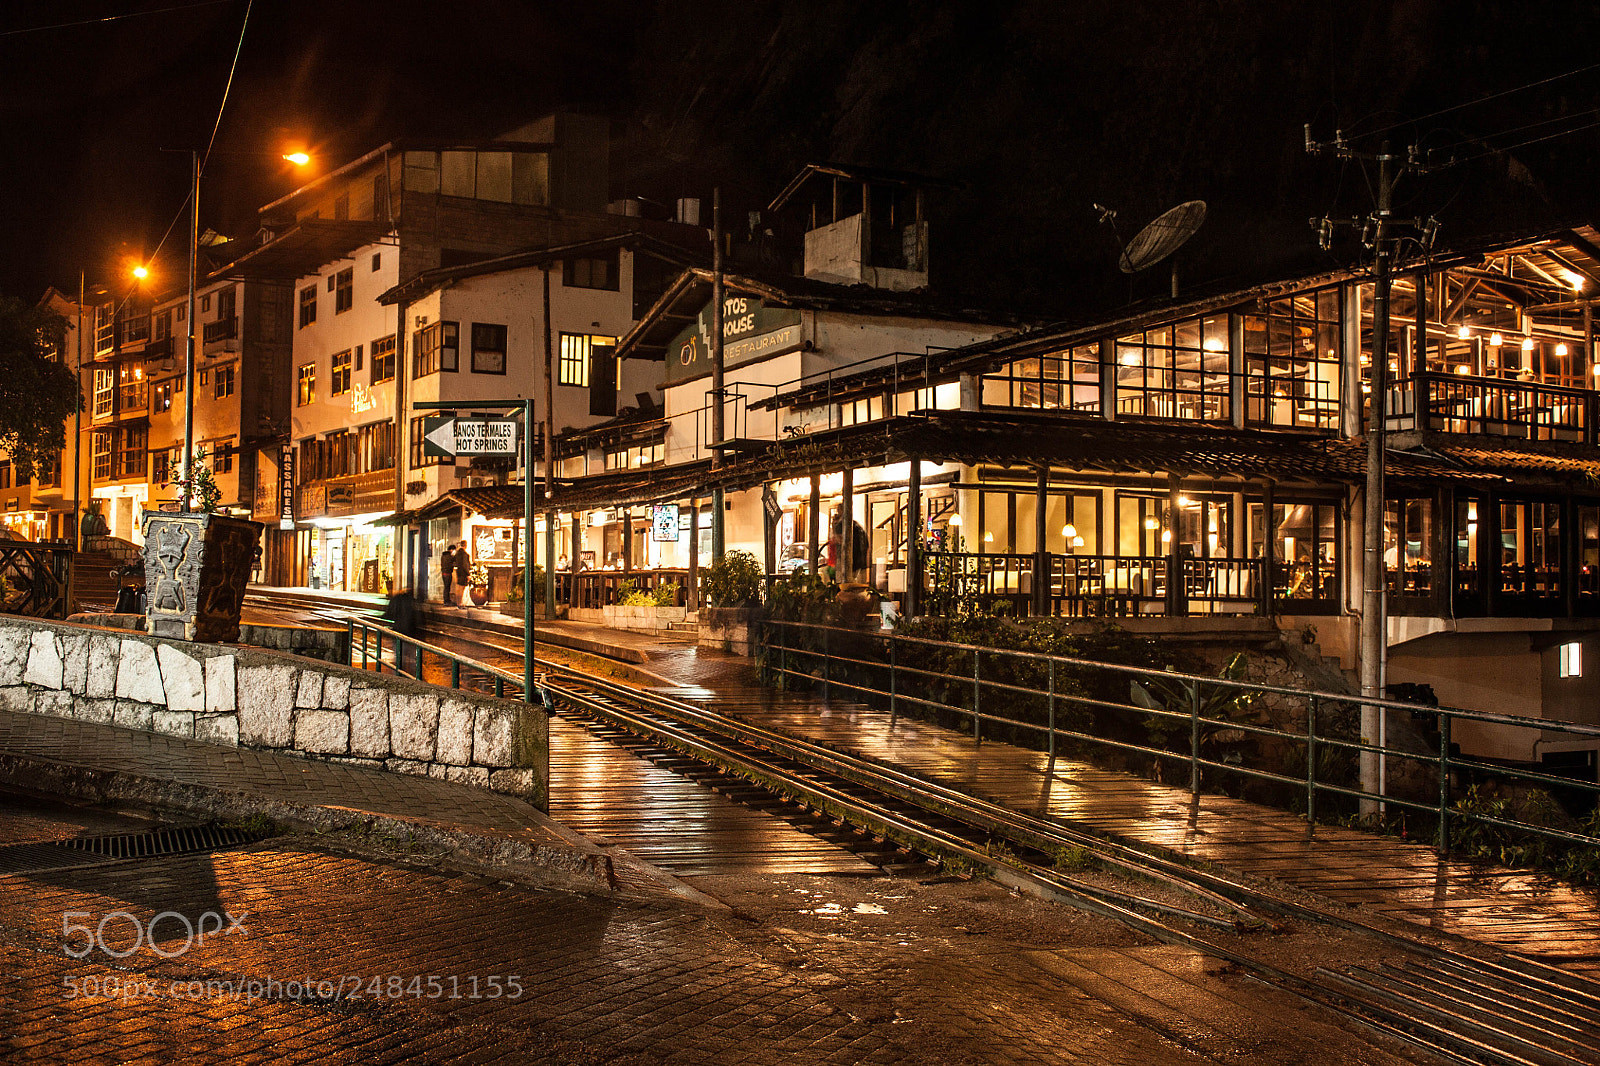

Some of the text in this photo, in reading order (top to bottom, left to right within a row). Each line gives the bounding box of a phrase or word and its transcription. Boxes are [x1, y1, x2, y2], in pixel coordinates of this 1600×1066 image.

[723, 331, 791, 361] RESTAURANT
[477, 424, 511, 437] TERMALES
[456, 439, 508, 450] HOT SPRINGS
[282, 445, 293, 515] MASSAGES
